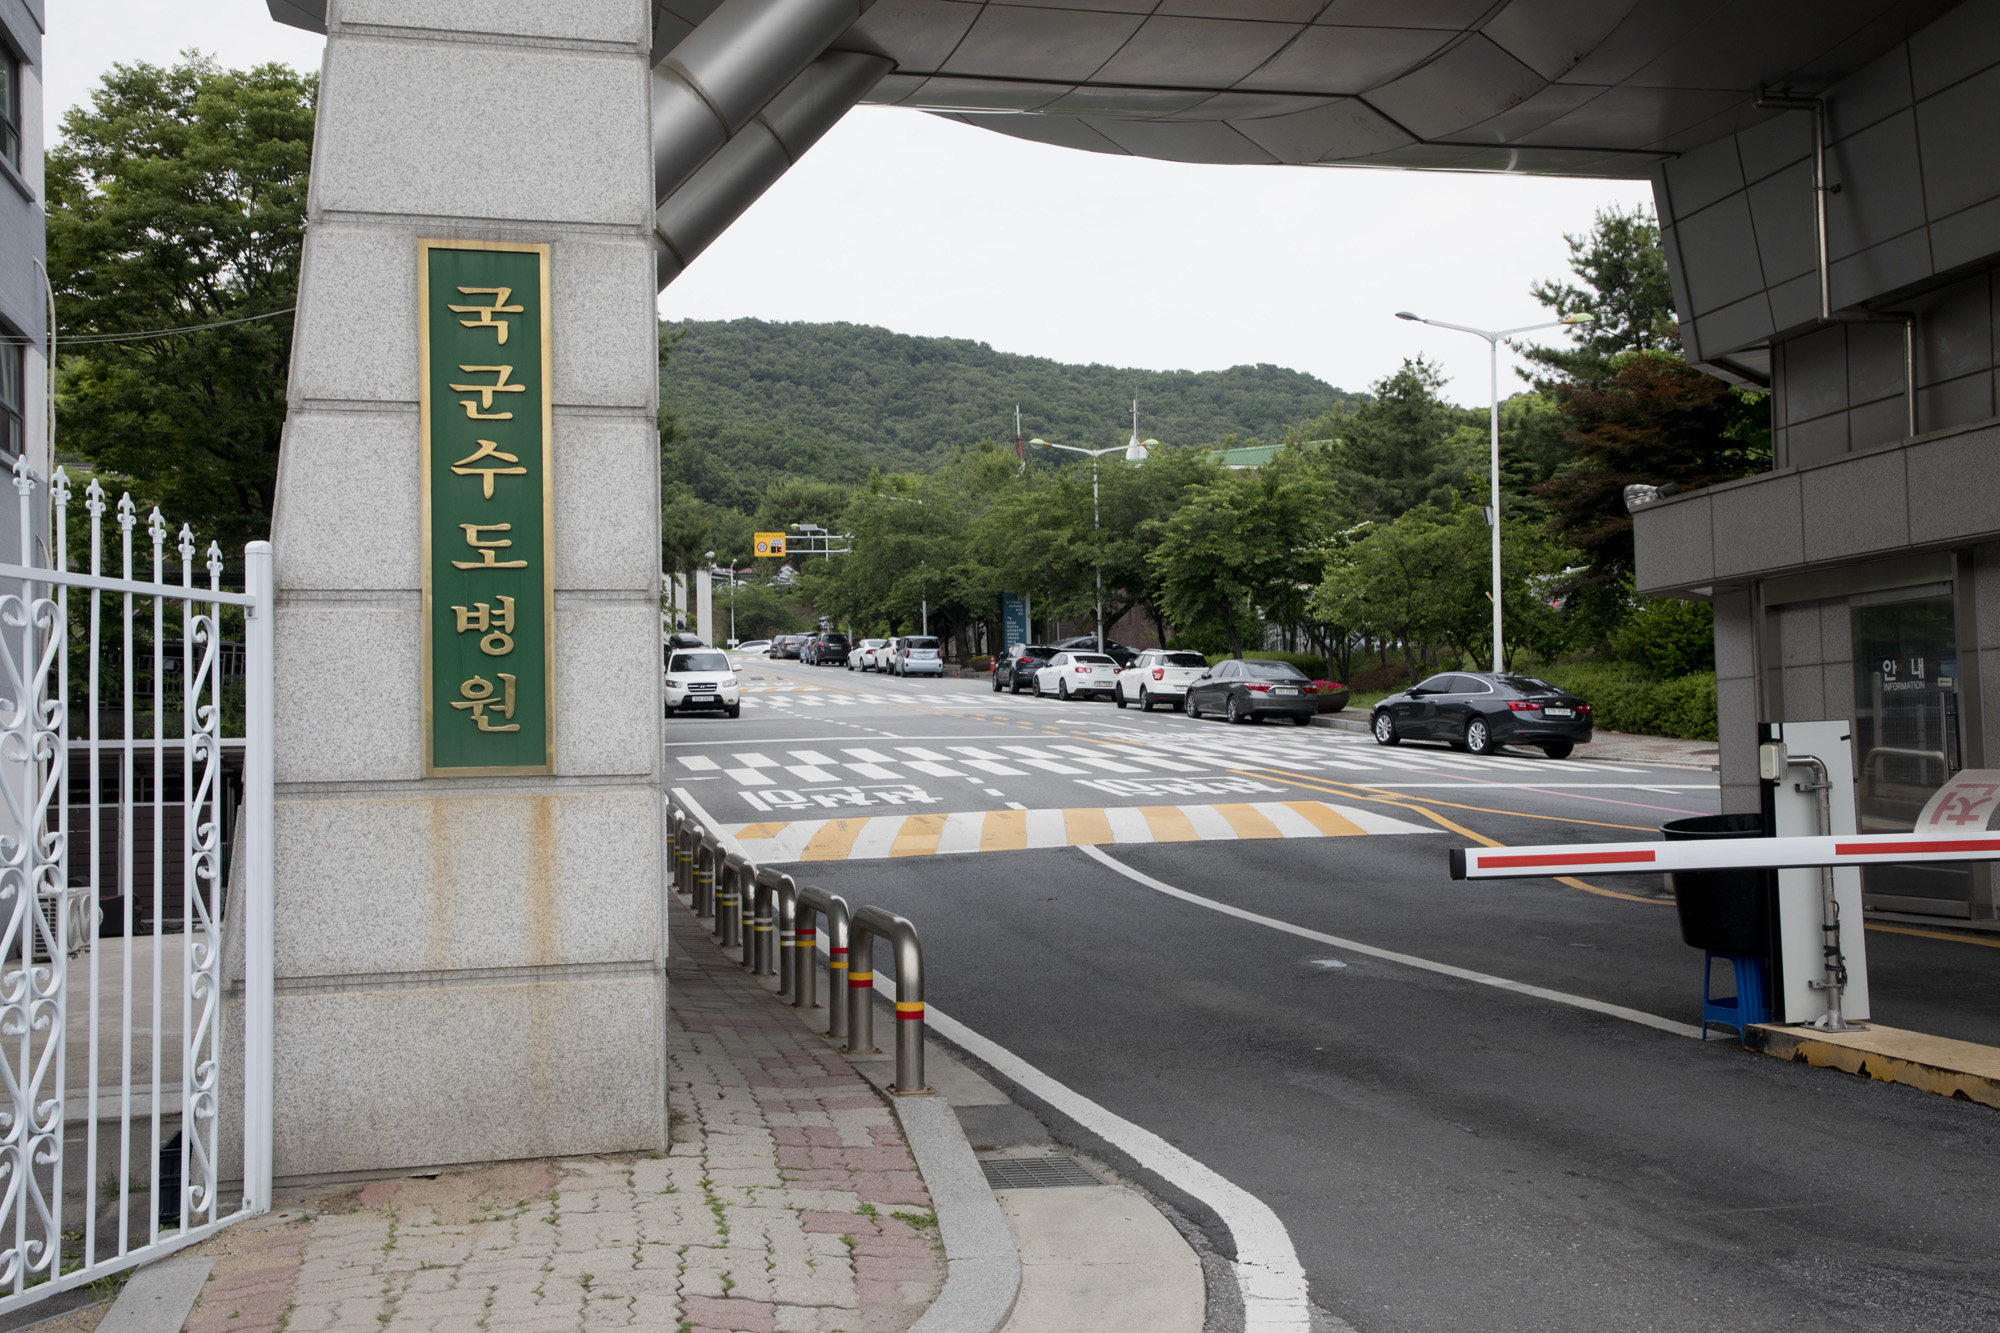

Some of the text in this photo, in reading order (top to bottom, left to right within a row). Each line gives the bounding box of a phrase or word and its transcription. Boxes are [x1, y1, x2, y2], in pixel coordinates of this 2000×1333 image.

[447, 286, 527, 733] 국군수도병원
[1883, 681, 1925, 691] INFORMATION
[737, 784, 943, 812] 천천히
[1072, 776, 1289, 797] 천천히
